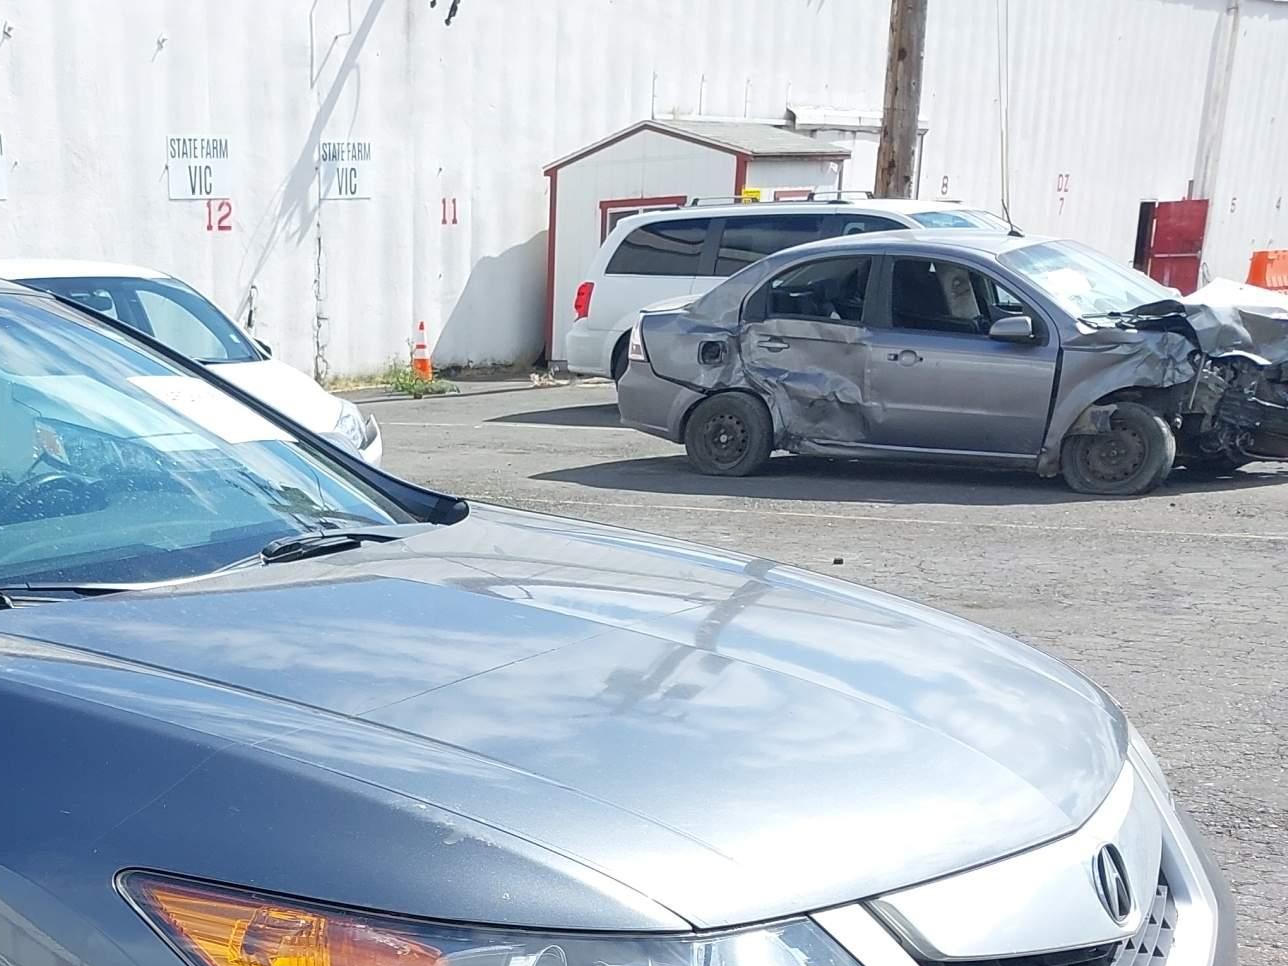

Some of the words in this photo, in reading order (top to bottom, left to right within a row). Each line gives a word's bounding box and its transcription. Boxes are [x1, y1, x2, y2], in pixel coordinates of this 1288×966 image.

[169, 137, 198, 159] STATE
[200, 138, 229, 159] FARM
[321, 142, 345, 162] STATE
[346, 142, 371, 161] FARM
[188, 165, 212, 195] VIC
[336, 167, 357, 196] VIC
[940, 175, 949, 195] 8
[206, 199, 233, 231] 12
[441, 197, 458, 225] 11
[1058, 197, 1065, 216] 7
